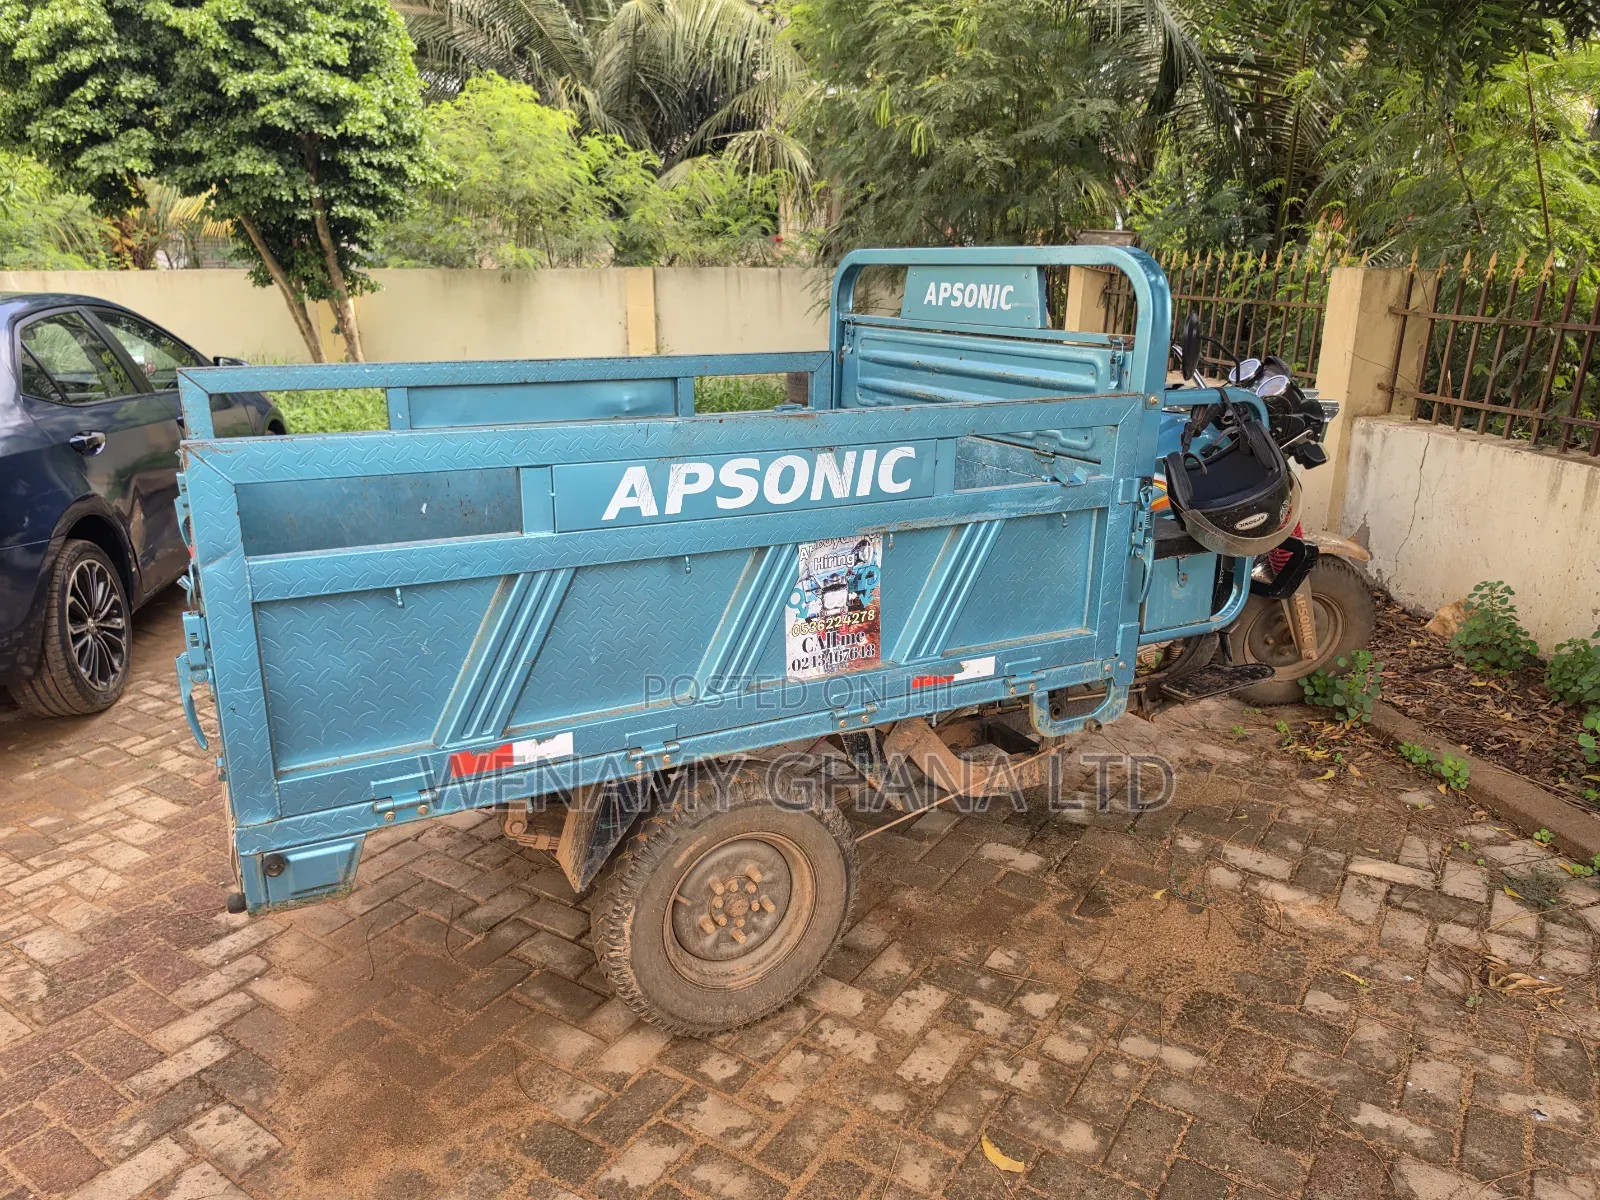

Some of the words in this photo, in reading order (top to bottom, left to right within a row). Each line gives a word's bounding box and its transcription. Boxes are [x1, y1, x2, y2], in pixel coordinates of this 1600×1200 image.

[923, 282, 1014, 311] APSONIC
[601, 446, 916, 521] APSONIC
[1238, 514, 1266, 528] APSONIC
[813, 553, 856, 571] Hiring
[791, 609, 876, 637] 0536224278
[1294, 592, 1314, 644] APSONIC
